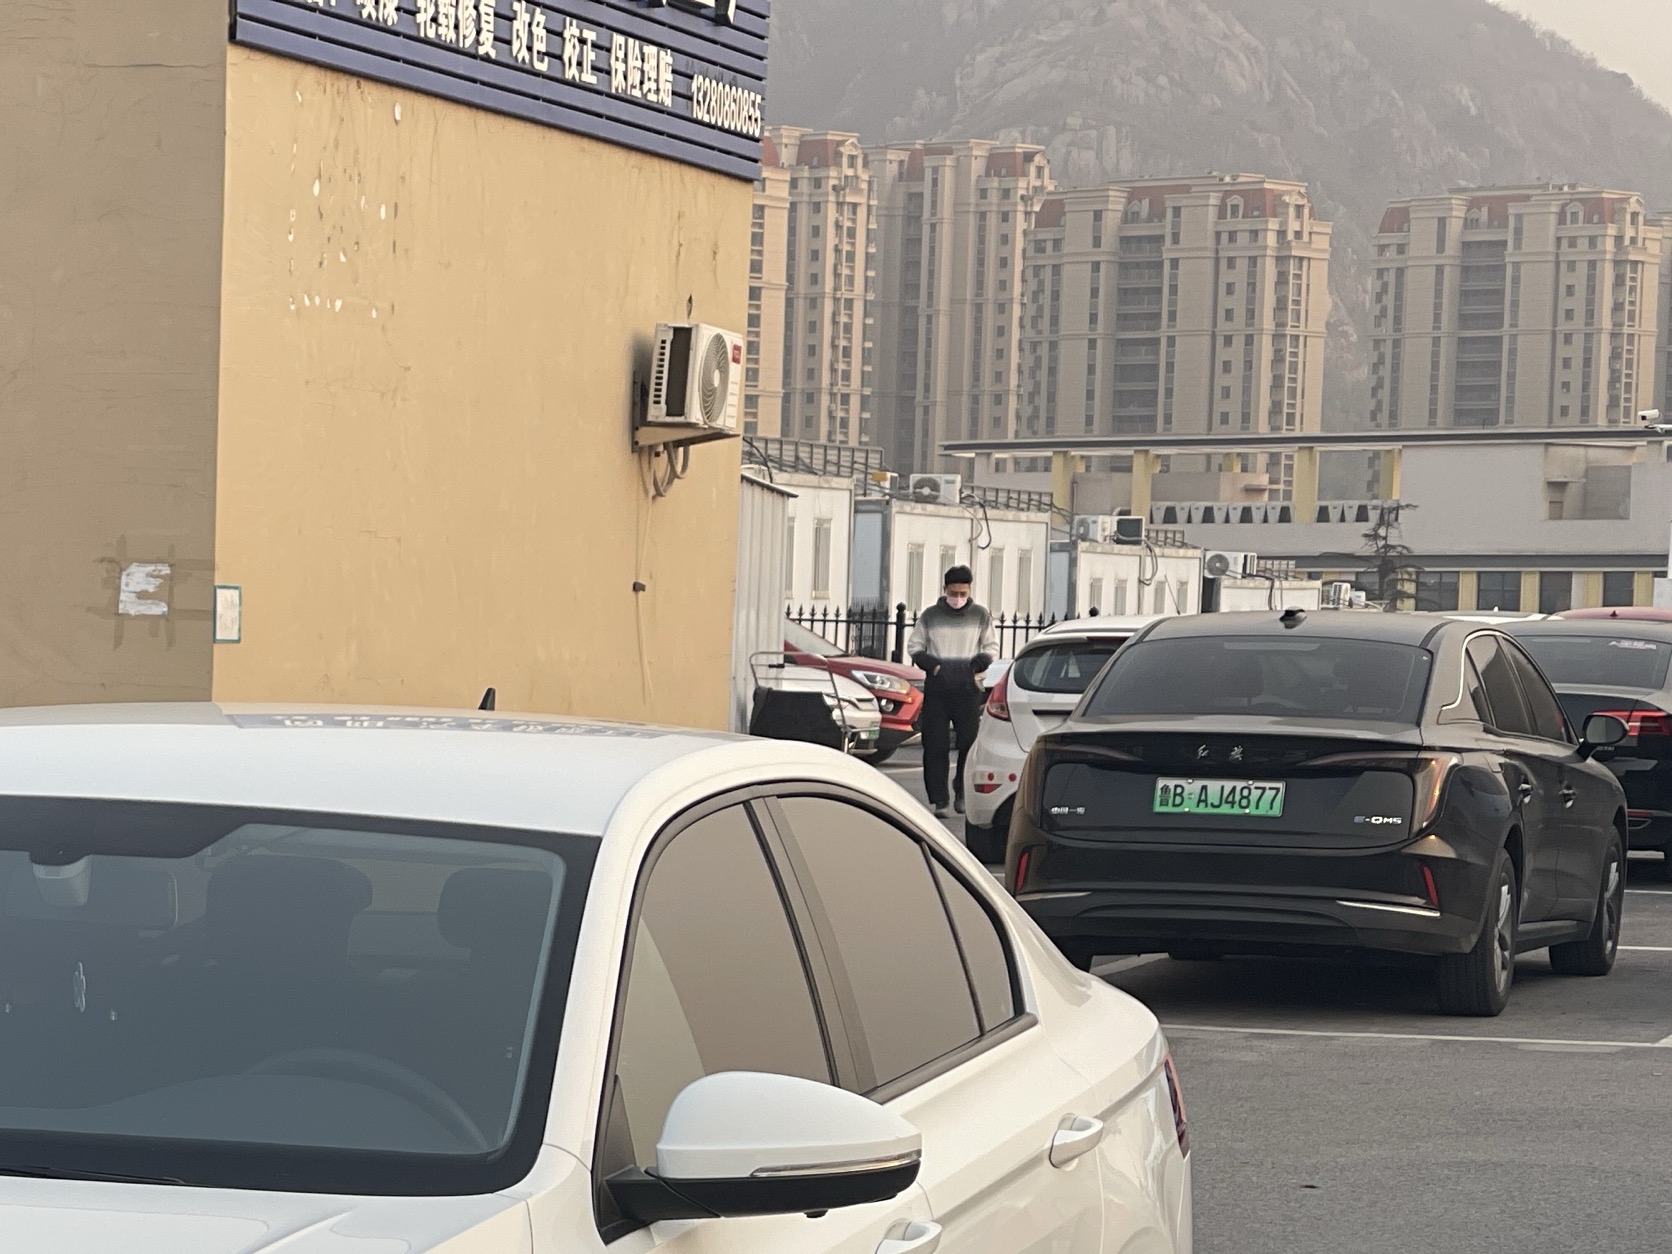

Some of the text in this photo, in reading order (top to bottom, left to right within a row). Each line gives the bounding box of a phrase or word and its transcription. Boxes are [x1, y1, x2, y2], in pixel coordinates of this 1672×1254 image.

[512, 0, 548, 72] 改色
[563, 17, 597, 84] 校正
[610, 32, 674, 107] 保险理赔
[691, 74, 762, 138] 13280860855
